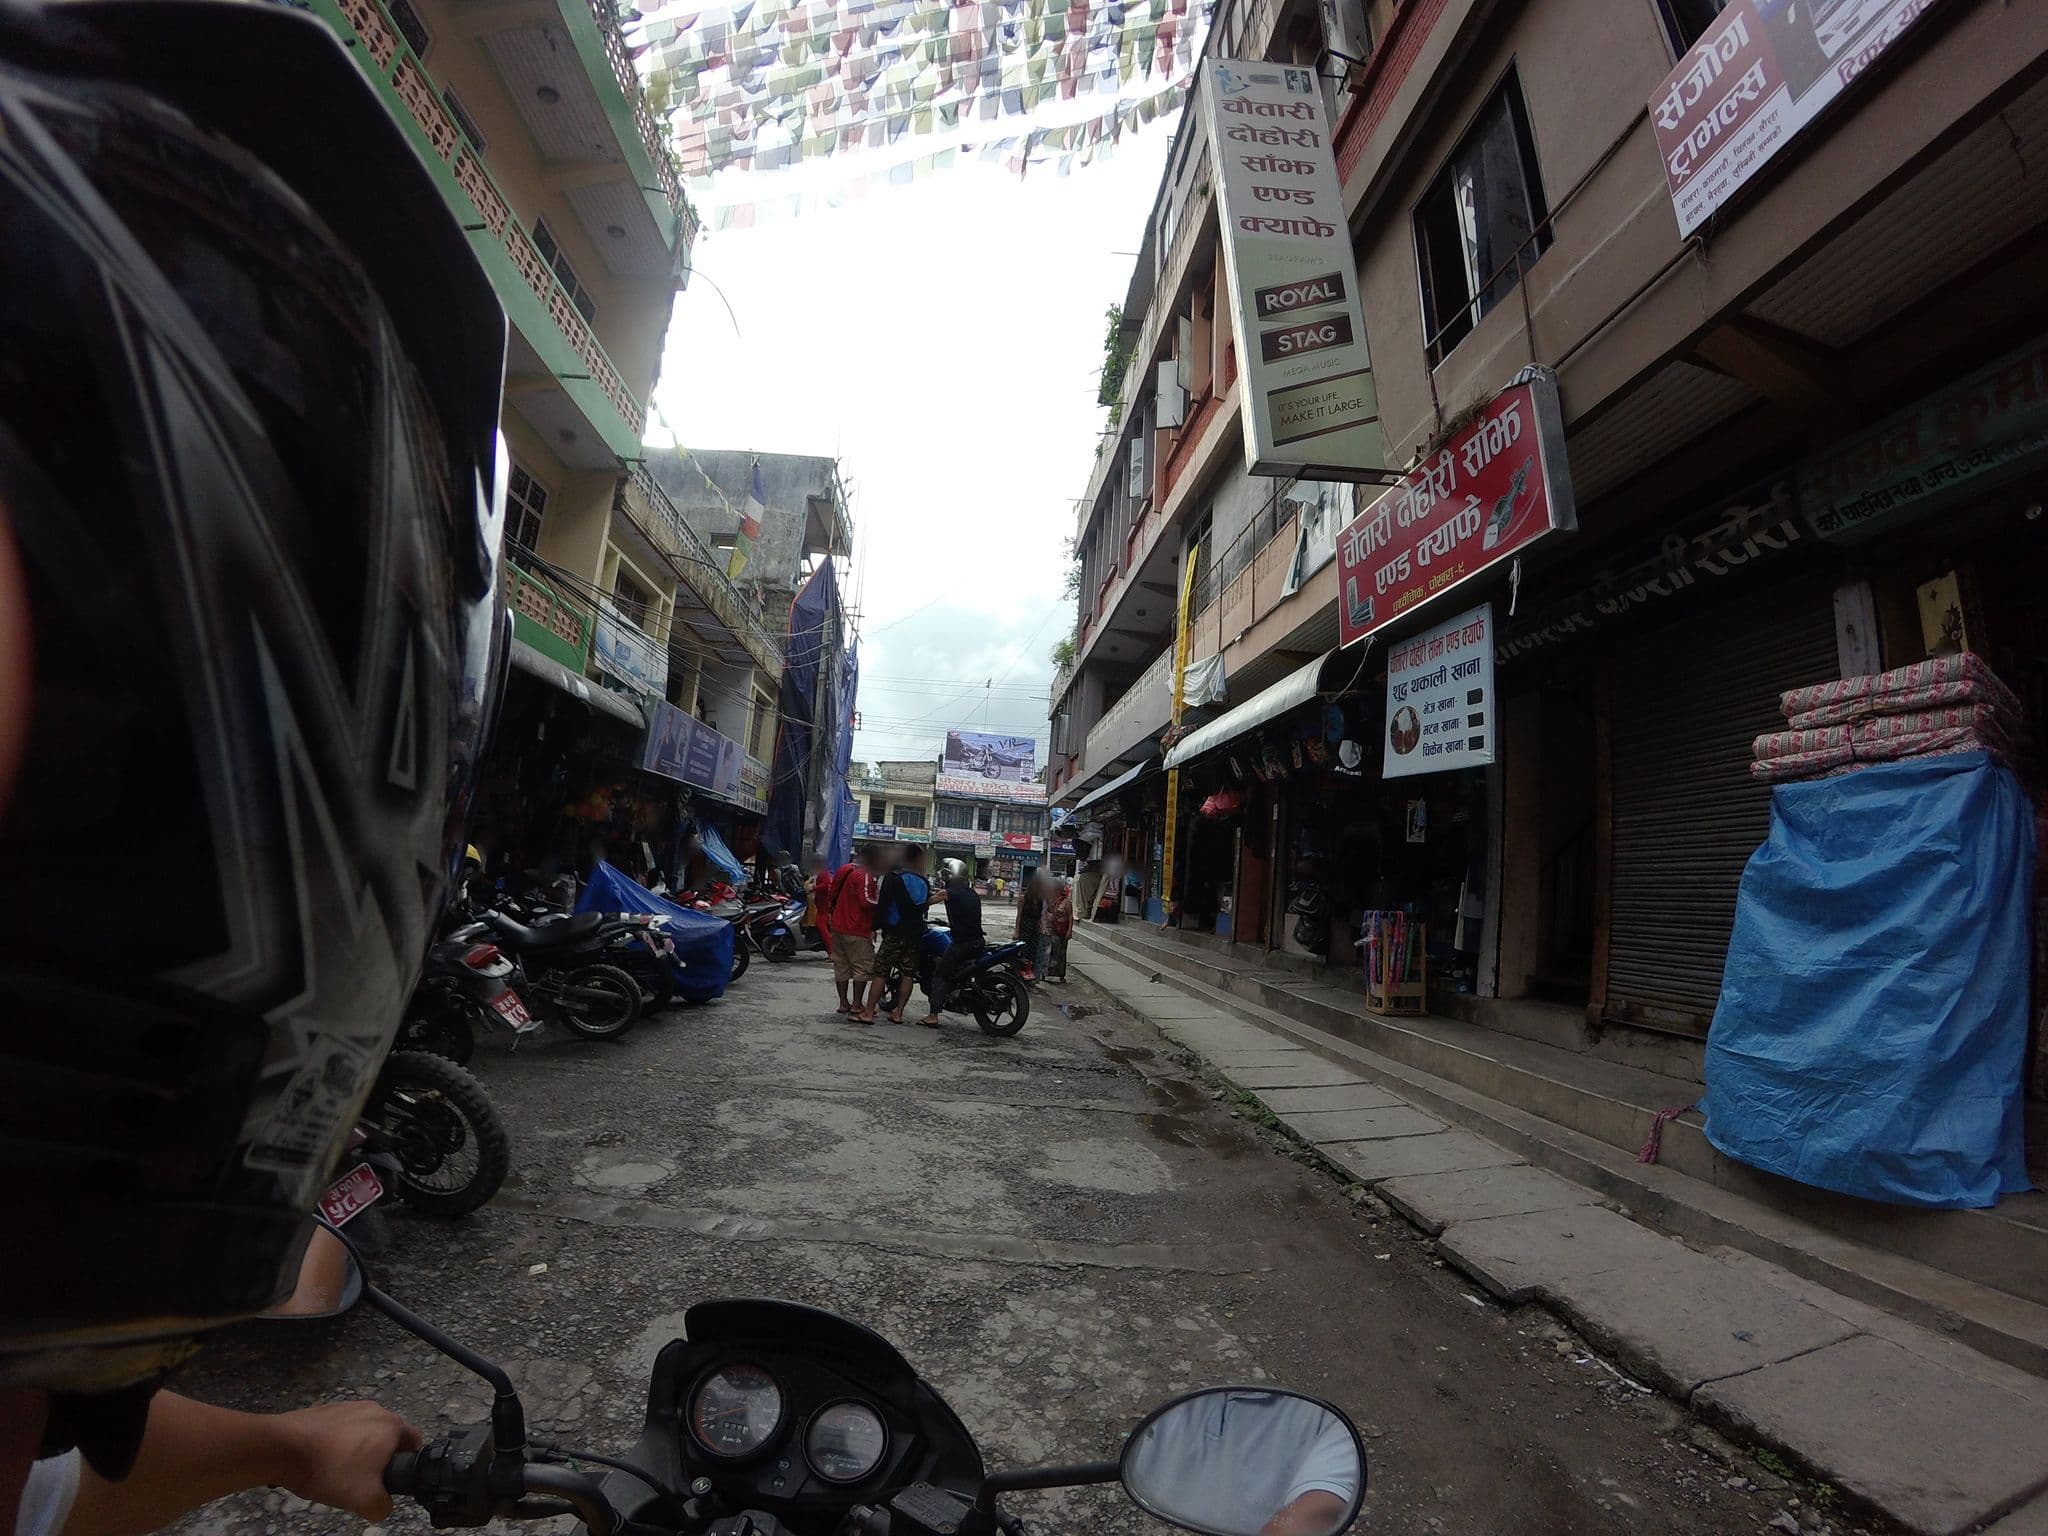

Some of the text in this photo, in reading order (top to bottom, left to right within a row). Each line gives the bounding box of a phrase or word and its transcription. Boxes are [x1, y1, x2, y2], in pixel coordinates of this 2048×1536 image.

[1654, 10, 1752, 131] संजोग
[1221, 96, 1315, 120] चौतारी
[1226, 123, 1320, 148] दोहोरी
[1251, 186, 1316, 205] एण्ड
[1240, 216, 1337, 237] क्याफे
[1264, 282, 1337, 311] ROYAL
[1278, 325, 1337, 352] STAG
[1294, 395, 1320, 408] YOUR
[1280, 410, 1314, 427] MAKE
[1316, 407, 1325, 418] IT
[1396, 450, 1457, 528] दोहोरी
[1375, 494, 1482, 595] एण्ड क्याफे
[1411, 664, 1447, 693] थकाली
[1451, 657, 1481, 681] खाना
[1423, 722, 1439, 736] मटन
